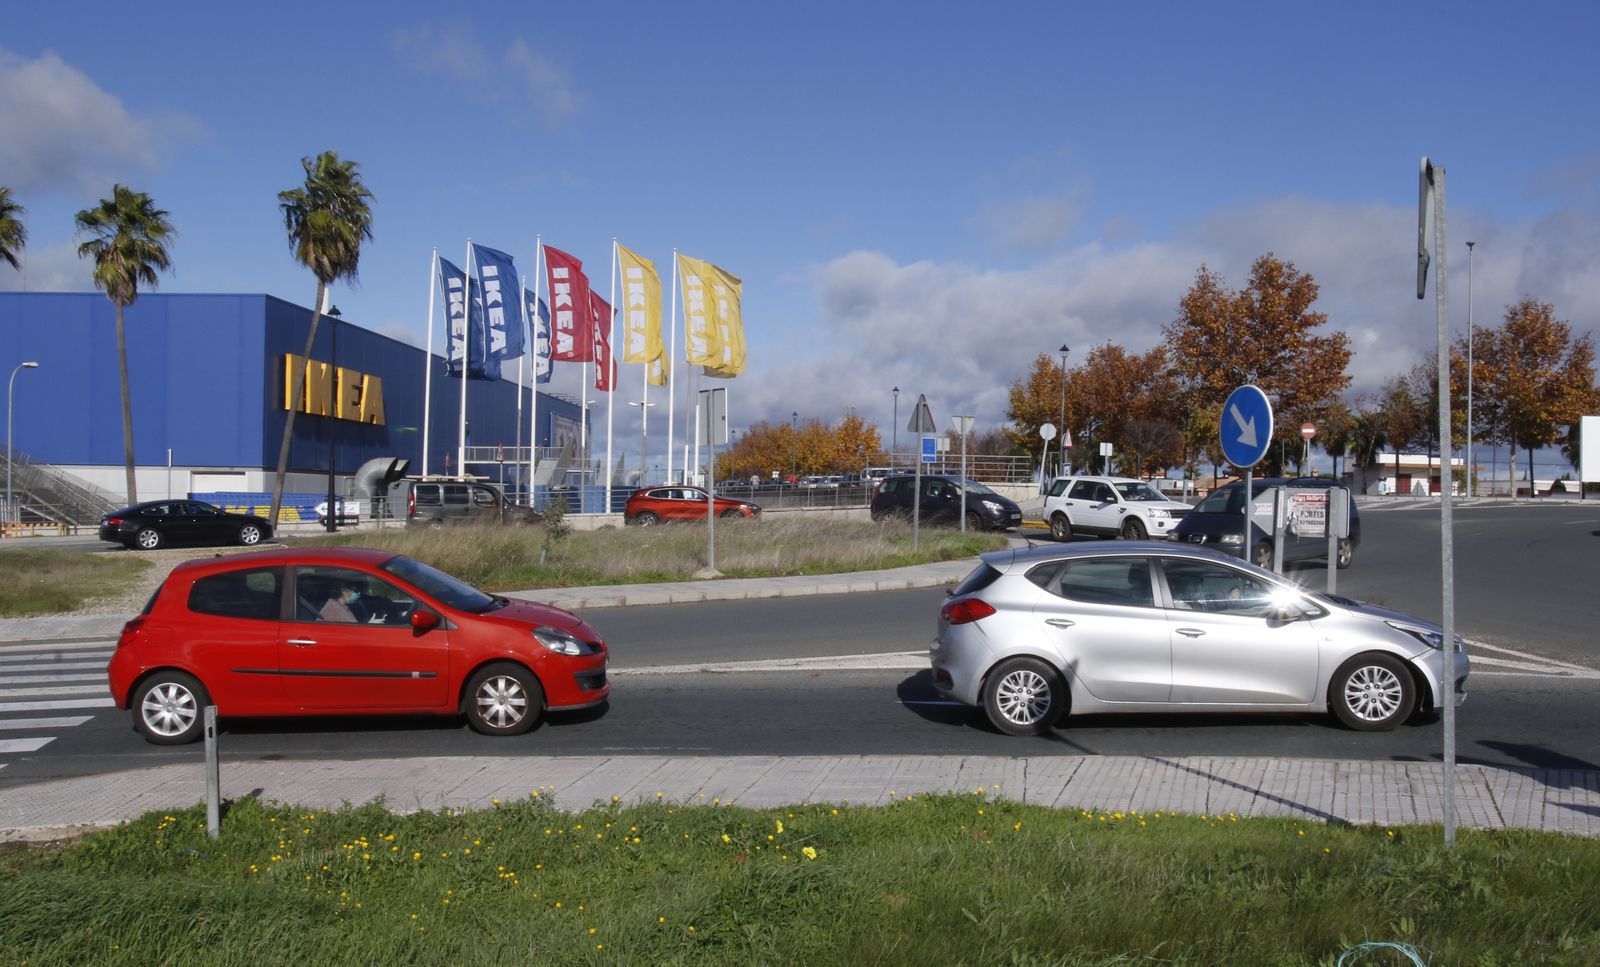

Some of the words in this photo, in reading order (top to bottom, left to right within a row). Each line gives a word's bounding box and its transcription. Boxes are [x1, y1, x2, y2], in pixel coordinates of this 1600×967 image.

[448, 277, 465, 361] IKEA
[482, 265, 507, 353] IKEA
[552, 267, 574, 354] IKEA
[626, 267, 645, 354] IKEA
[686, 275, 707, 358] IKEA
[285, 353, 386, 425] IKEA
